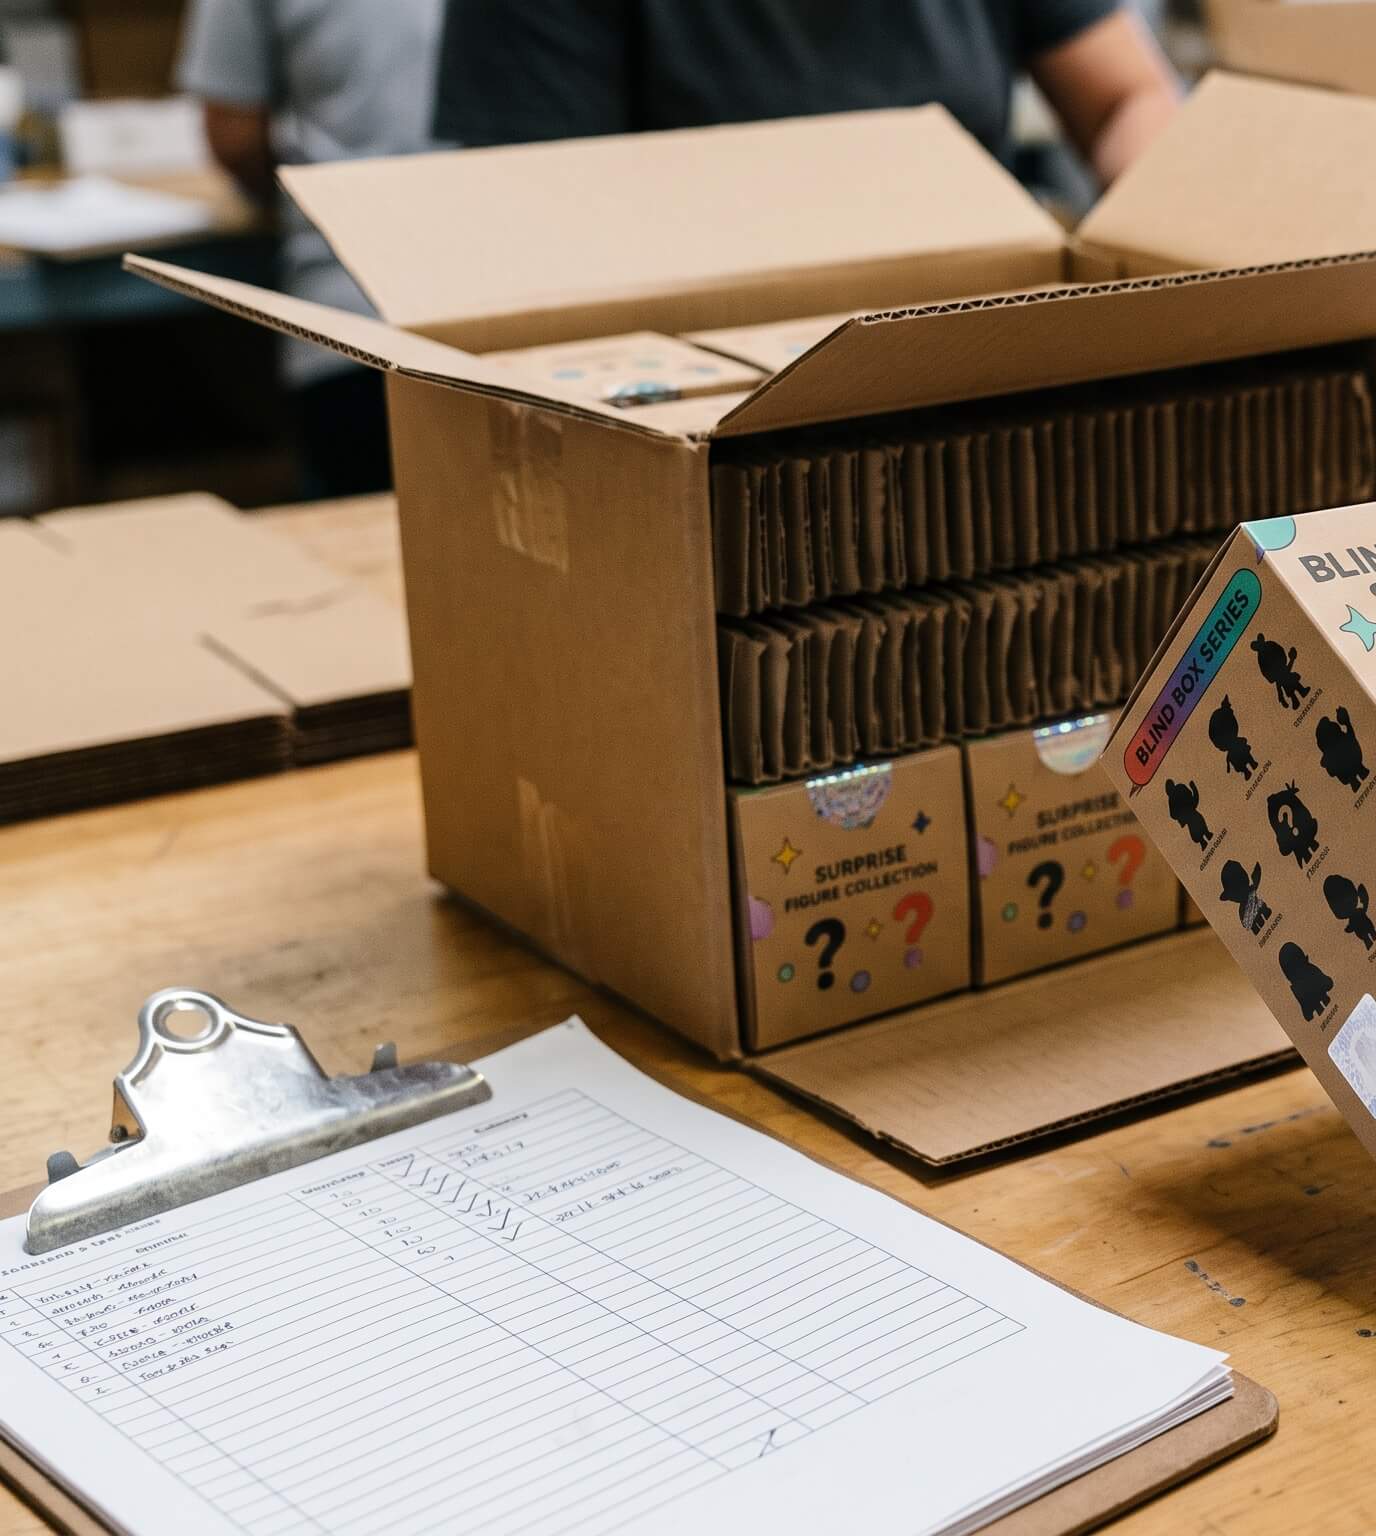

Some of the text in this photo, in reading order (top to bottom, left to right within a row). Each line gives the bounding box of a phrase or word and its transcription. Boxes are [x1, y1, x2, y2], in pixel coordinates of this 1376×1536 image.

[1135, 589, 1249, 767] BLIND BOX SERIES
[1038, 791, 1119, 828] SURPRISE
[815, 844, 906, 883] SURPRISE
[784, 861, 938, 912] FIGURE COLLECTION
